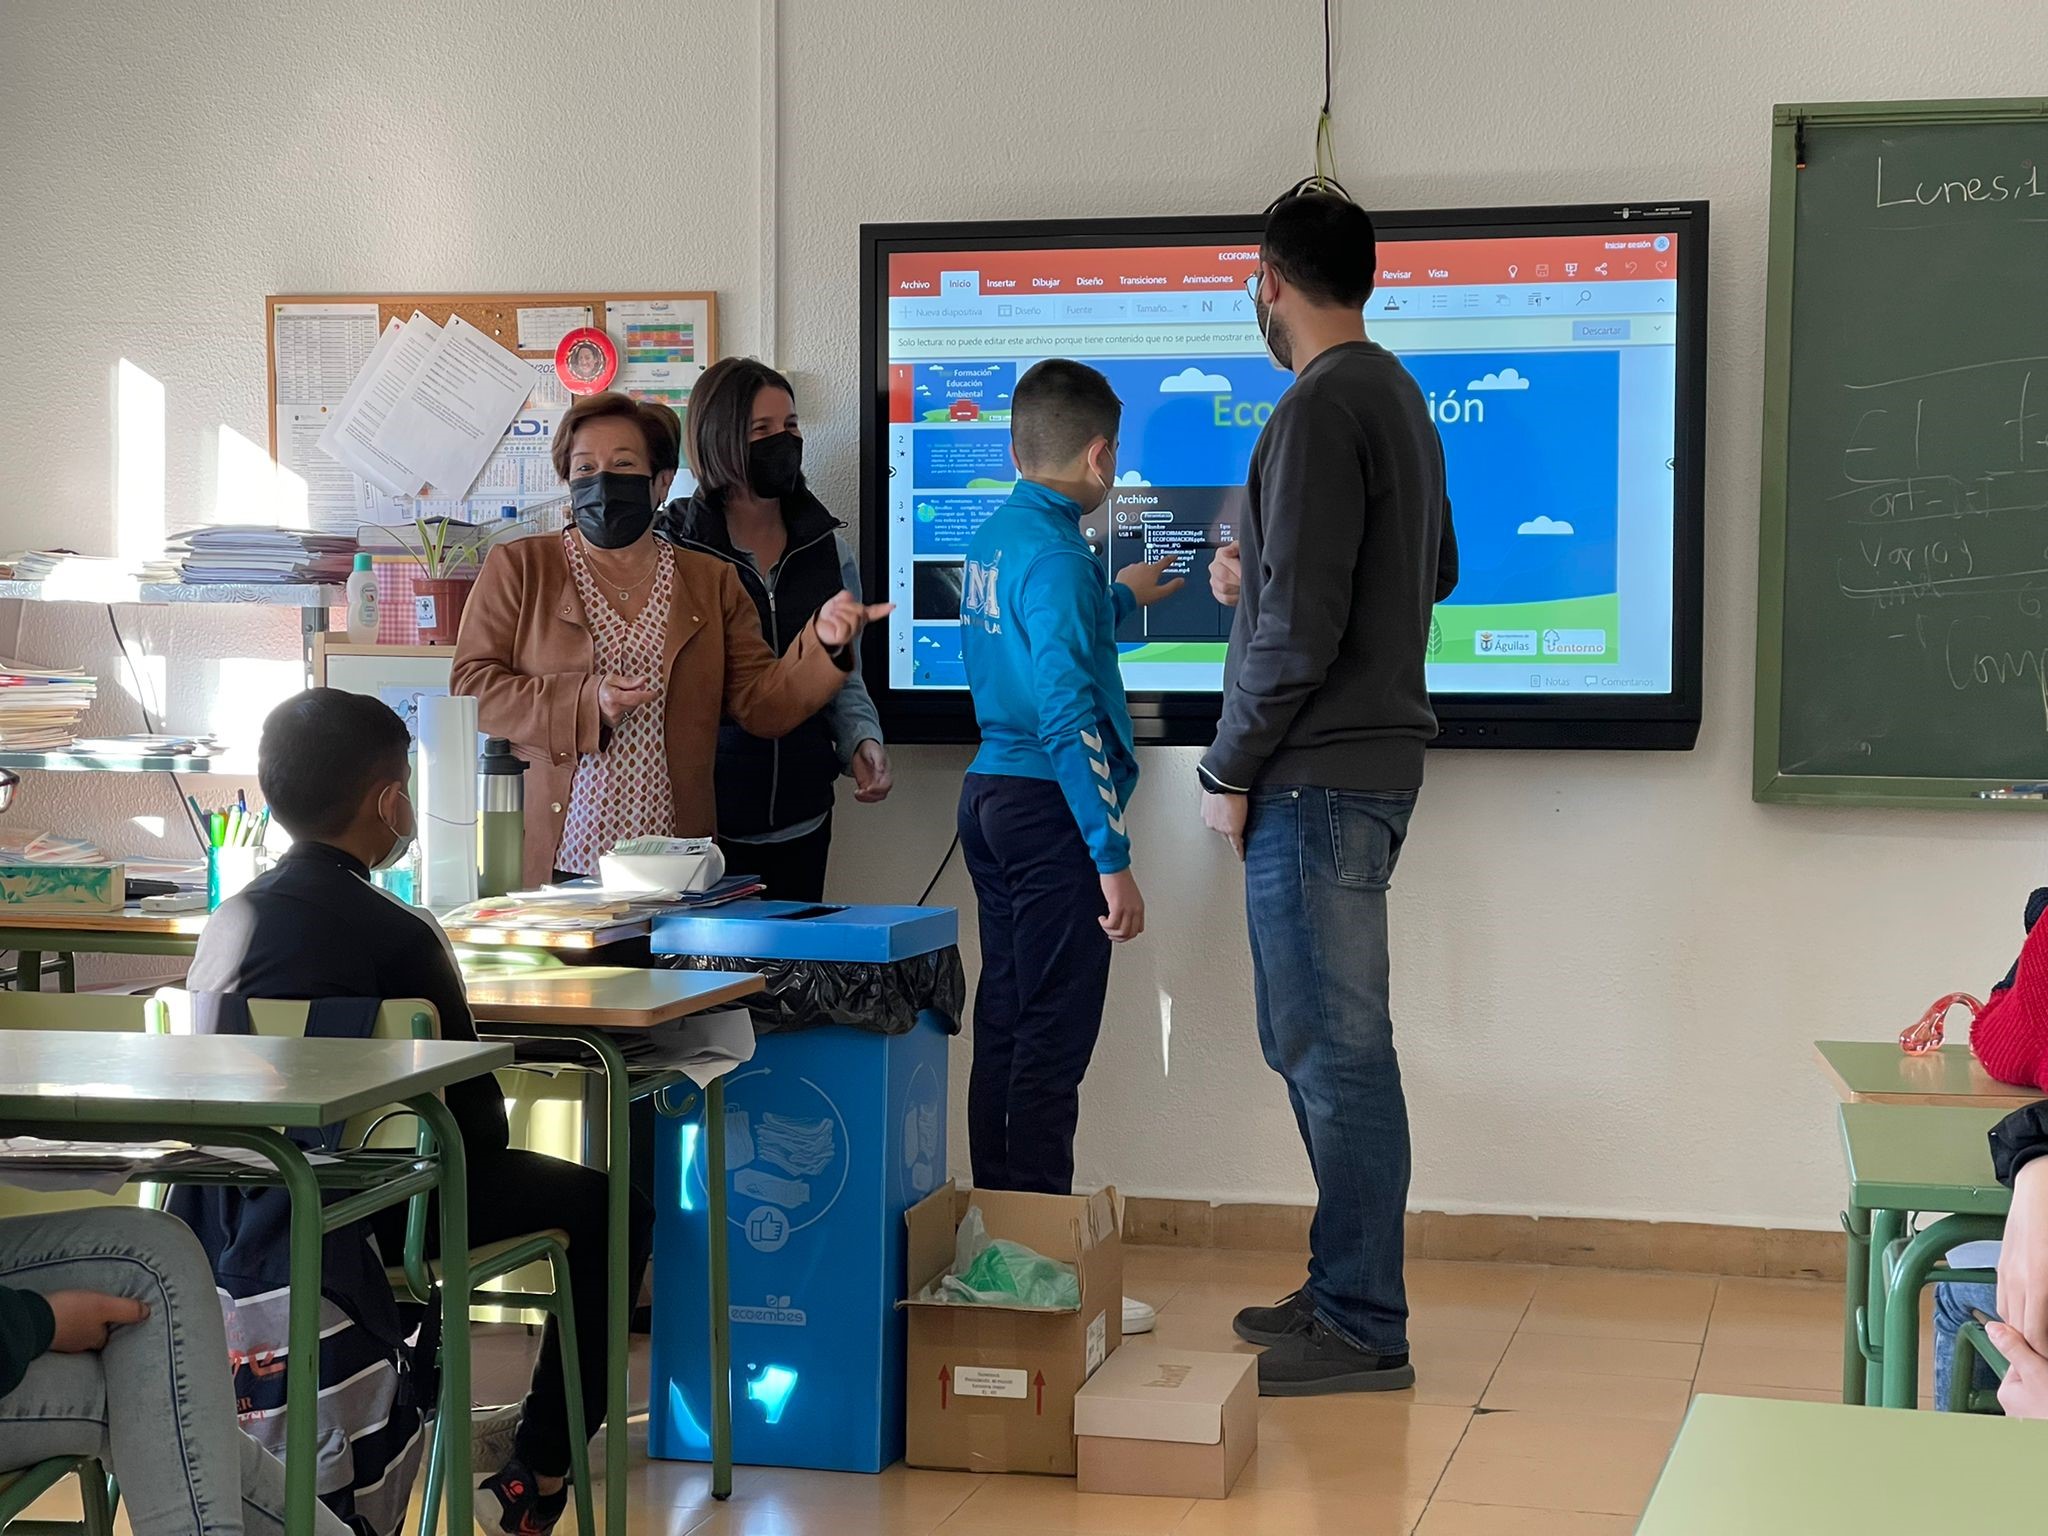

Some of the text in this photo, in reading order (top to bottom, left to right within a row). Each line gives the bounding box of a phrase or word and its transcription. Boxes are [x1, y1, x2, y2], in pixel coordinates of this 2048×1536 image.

[1218, 252, 1260, 261] ECOFORMA
[1382, 270, 1412, 279] Revisar
[1428, 268, 1449, 278] Vista
[949, 279, 972, 288] Inicio
[986, 279, 1016, 288] Insertar
[1032, 278, 1060, 288] Dibujar
[1076, 276, 1104, 287] Diseño
[1119, 276, 1167, 286] Transiciones
[1183, 275, 1233, 284] Animaciones
[900, 280, 930, 289] Archivo
[1066, 305, 1093, 314] Fuente
[1202, 300, 1213, 312] N
[1233, 299, 1242, 312] K
[915, 309, 940, 317] Nueva
[1015, 305, 1042, 316] Diseño
[1582, 326, 1621, 336] Descartar
[898, 338, 916, 347] Solo
[958, 338, 983, 348] puede
[984, 336, 1006, 345] editar
[1008, 337, 1025, 345] este
[1025, 335, 1053, 345] archivo
[1054, 336, 1085, 346] porque
[1084, 335, 1104, 344] tiene
[1105, 333, 1144, 344] contenido
[1146, 335, 1161, 345] que
[1175, 334, 1185, 342] se
[1186, 332, 1211, 343] puede
[1212, 332, 1243, 342] mostrar
[954, 369, 992, 377] Formación
[946, 390, 984, 398] Ambiental
[899, 435, 904, 443] 2
[1116, 494, 1159, 504] Archivos
[899, 501, 904, 510] 3
[899, 632, 904, 640] 5
[1495, 640, 1530, 653] Águilas
[1545, 678, 1570, 686] Notas
[1601, 677, 1654, 687] Comentarios
[731, 1308, 804, 1323] ecoembes
